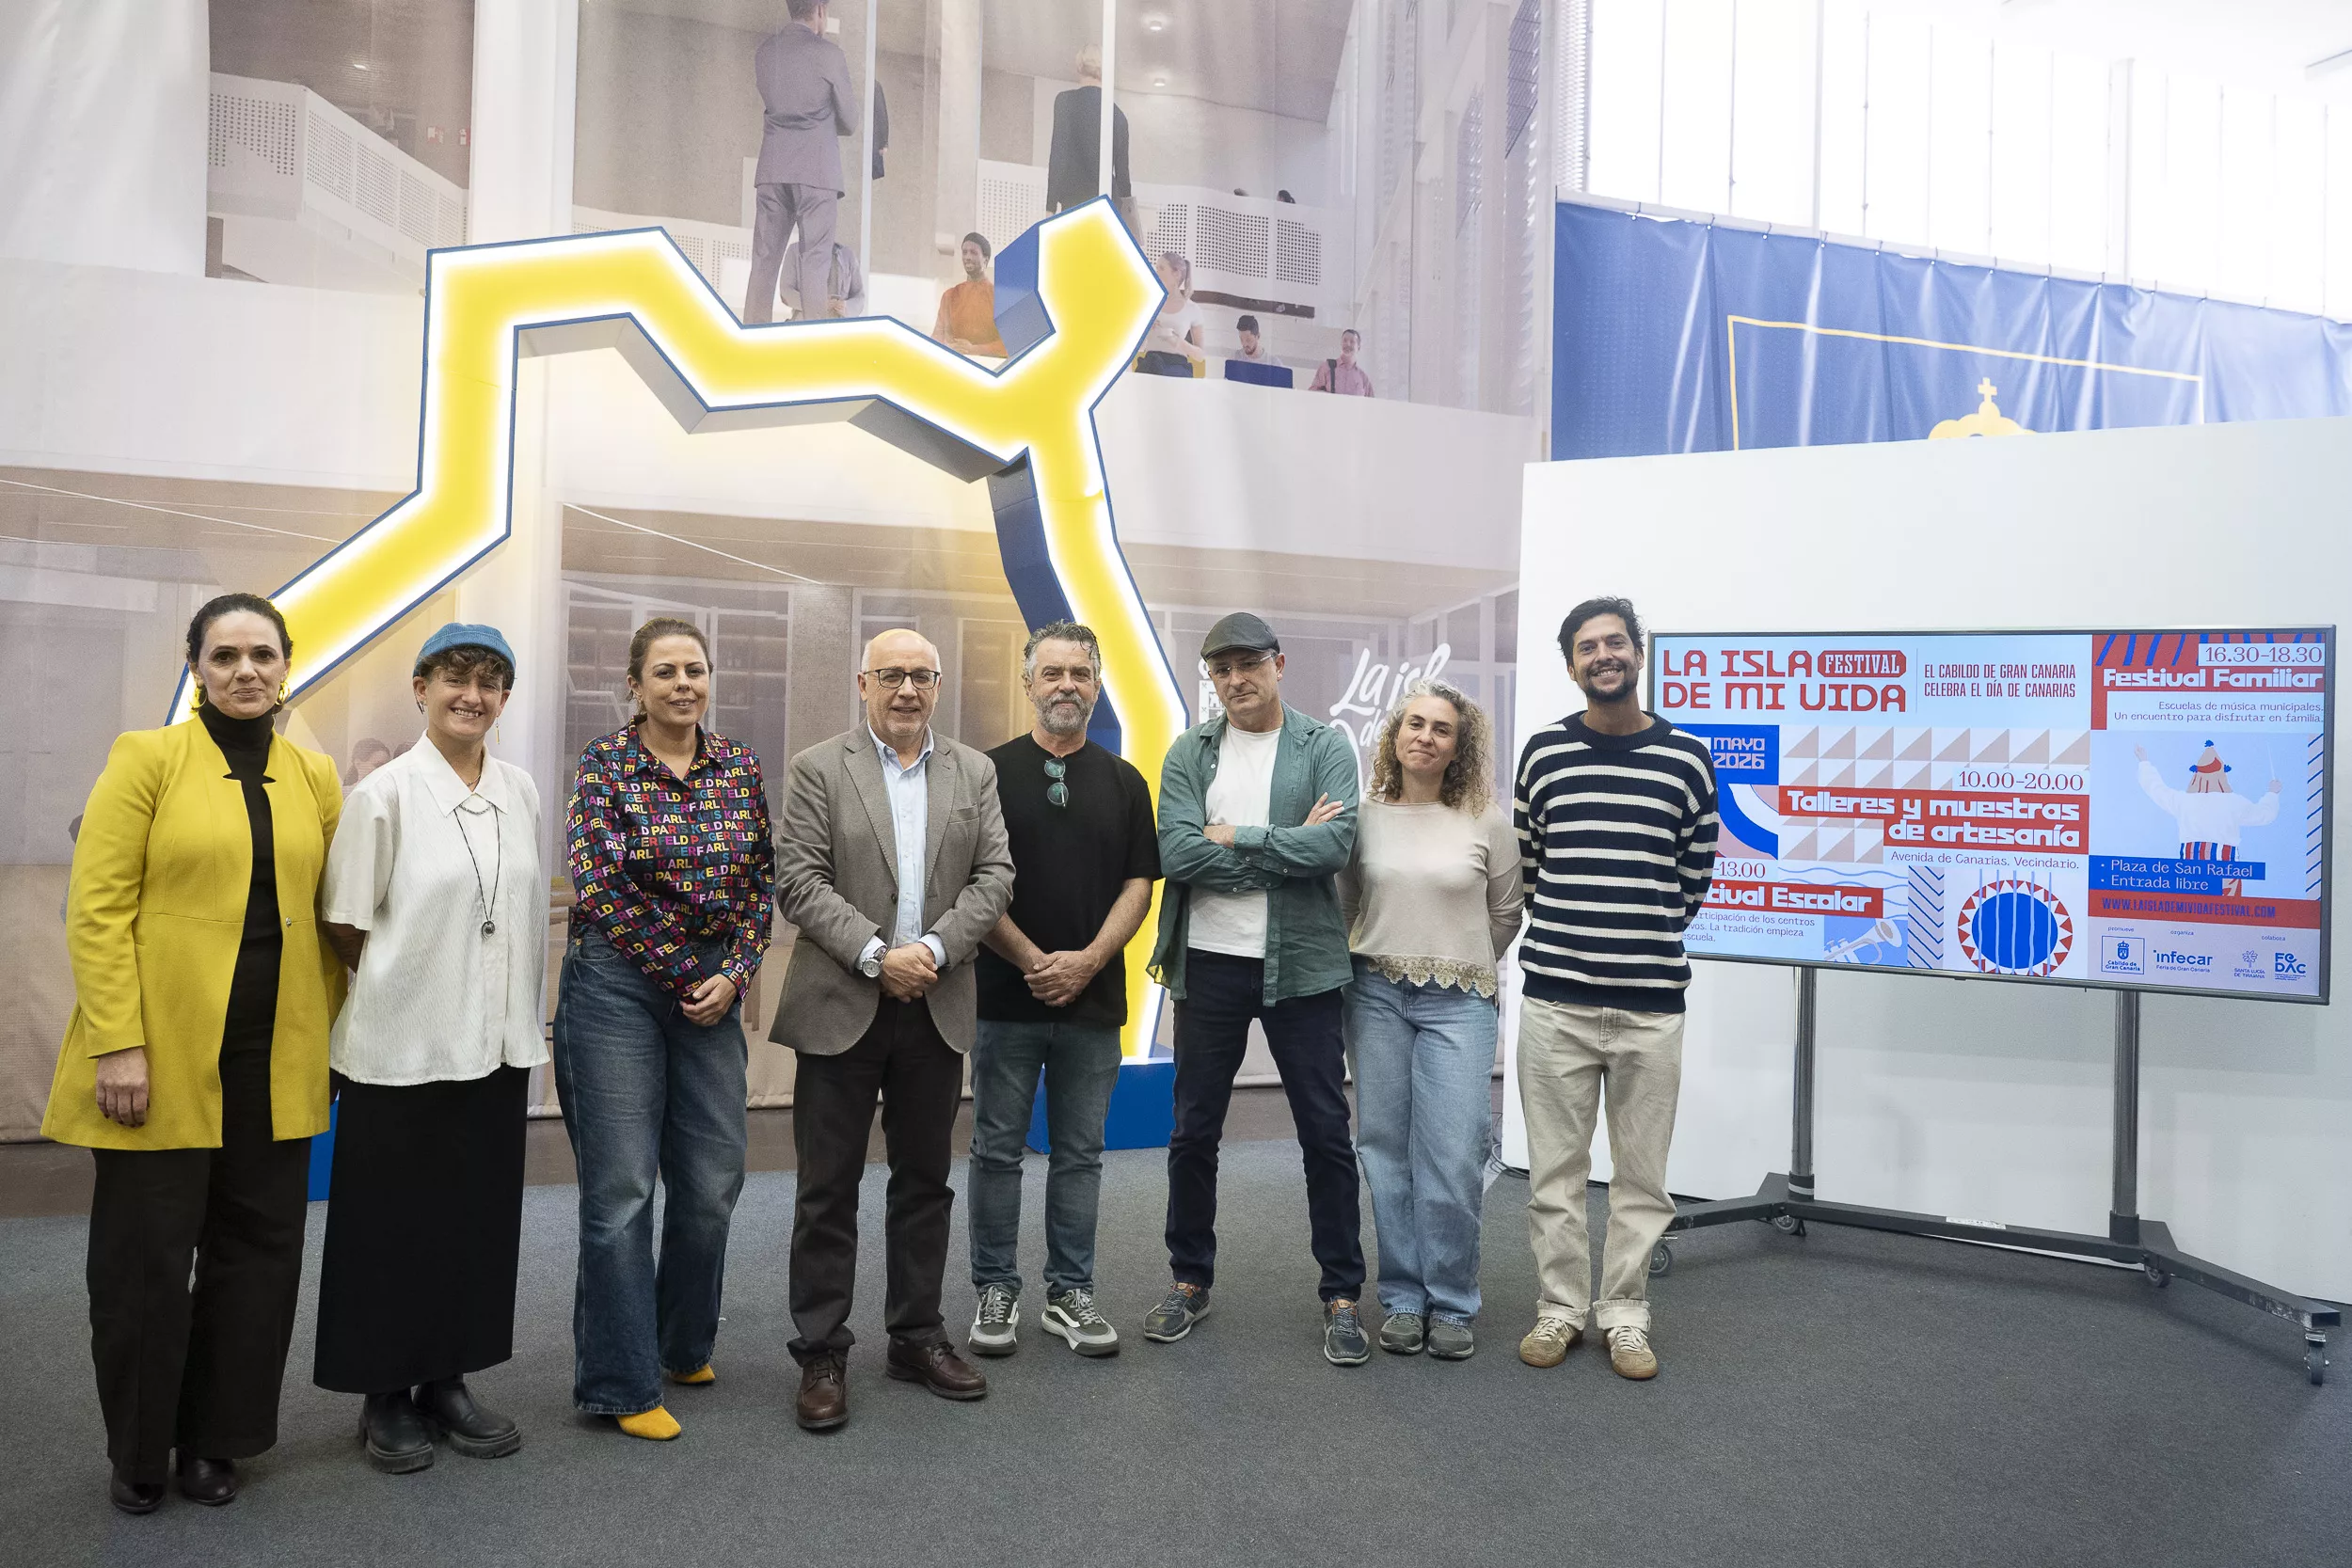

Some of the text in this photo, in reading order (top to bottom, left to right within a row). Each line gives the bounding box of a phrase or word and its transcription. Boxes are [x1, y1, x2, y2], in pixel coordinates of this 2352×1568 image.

[1663, 649, 1900, 677] LA ISLA FESTIVAL
[2205, 646, 2323, 663] 16.30-18.30
[1924, 664, 2076, 679] EL CABILDO DE GRAN CANARIA
[2103, 668, 2324, 688] Festival Familiar
[1329, 648, 1390, 717] La
[1924, 679, 2076, 698] CELEBRA EL DÍA DE CANARIAS
[1663, 682, 1710, 709] DE
[1725, 683, 1785, 710] MI
[2114, 712, 2123, 721] Un
[2215, 712, 2265, 722] disfrutar
[2285, 713, 2324, 722] familia.
[2158, 702, 2324, 713] Escuelas de música municipales.
[1714, 737, 1765, 751] MAYO
[1713, 752, 1765, 768] 2026
[1959, 771, 2084, 791] 10.00-20.00
[1788, 790, 2080, 820] Talleres y muestras
[1888, 818, 2080, 847] de artesanía
[1890, 850, 2080, 869] Avenida de Canarias. Vecindario.
[2110, 859, 2253, 878] Plaza de San Rafael
[1713, 861, 1766, 879] -13.00
[2111, 875, 2209, 891] Entrada libre
[1772, 886, 1872, 912] Escolar
[2101, 896, 2276, 919] WWW.LAISLADEMIVIDAFESTIVAL.COM
[1709, 923, 1720, 931] La
[1724, 925, 1764, 934] tradición
[1766, 927, 1804, 937] empieza
[1748, 914, 1760, 923] de
[1762, 915, 1775, 924] los
[1777, 917, 1815, 927] centros
[2153, 949, 2214, 966] infecar
